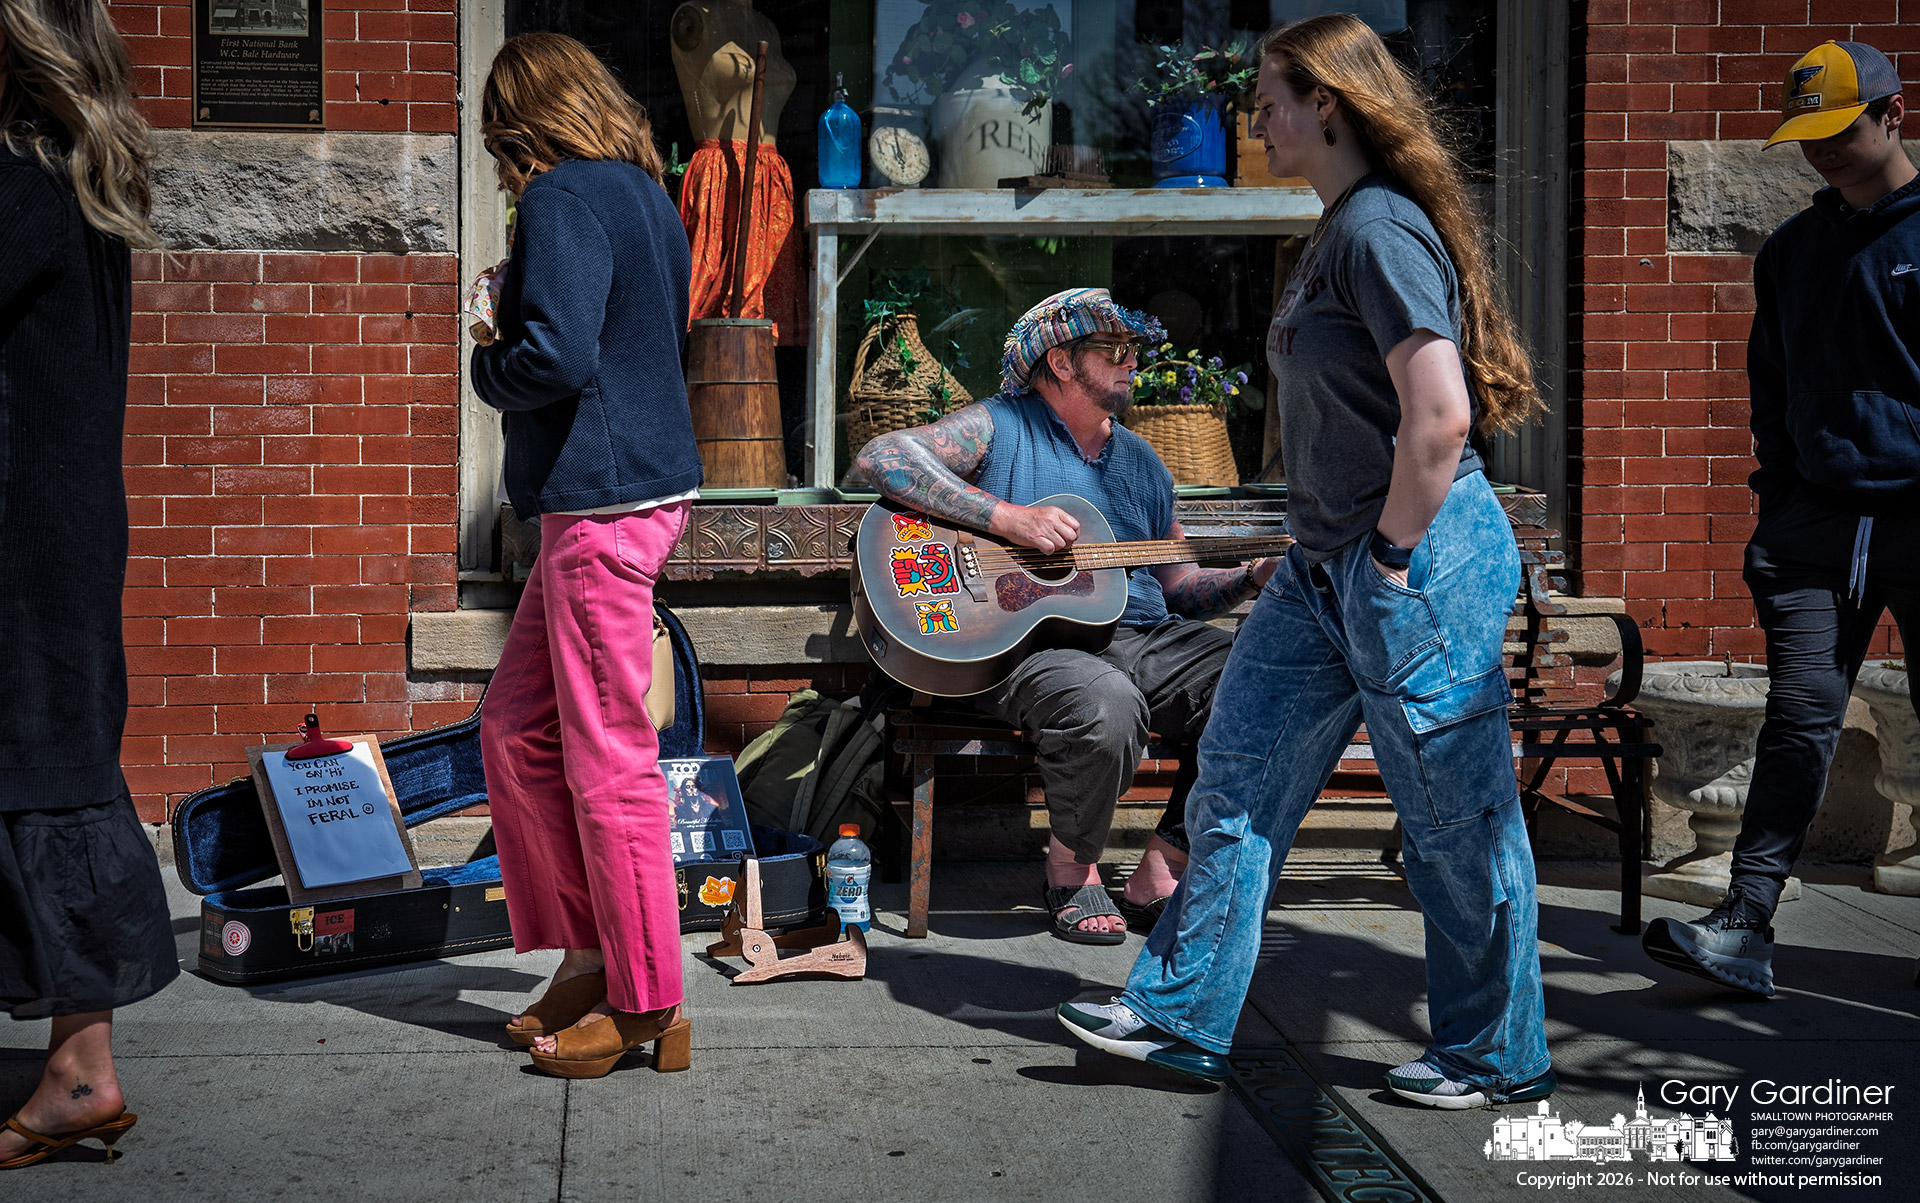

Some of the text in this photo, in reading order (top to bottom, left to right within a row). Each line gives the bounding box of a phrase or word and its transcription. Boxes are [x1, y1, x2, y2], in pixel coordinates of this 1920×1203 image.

[221, 39, 298, 48] First National Bank
[261, 50, 299, 59] Hardware
[288, 758, 339, 771] YOU CAN
[306, 770, 322, 778] SAY
[294, 780, 360, 796] I PROMISE
[326, 794, 350, 806] NOT
[308, 808, 360, 825] FERAL
[836, 886, 862, 896] ZERO
[325, 914, 344, 925] ICE
